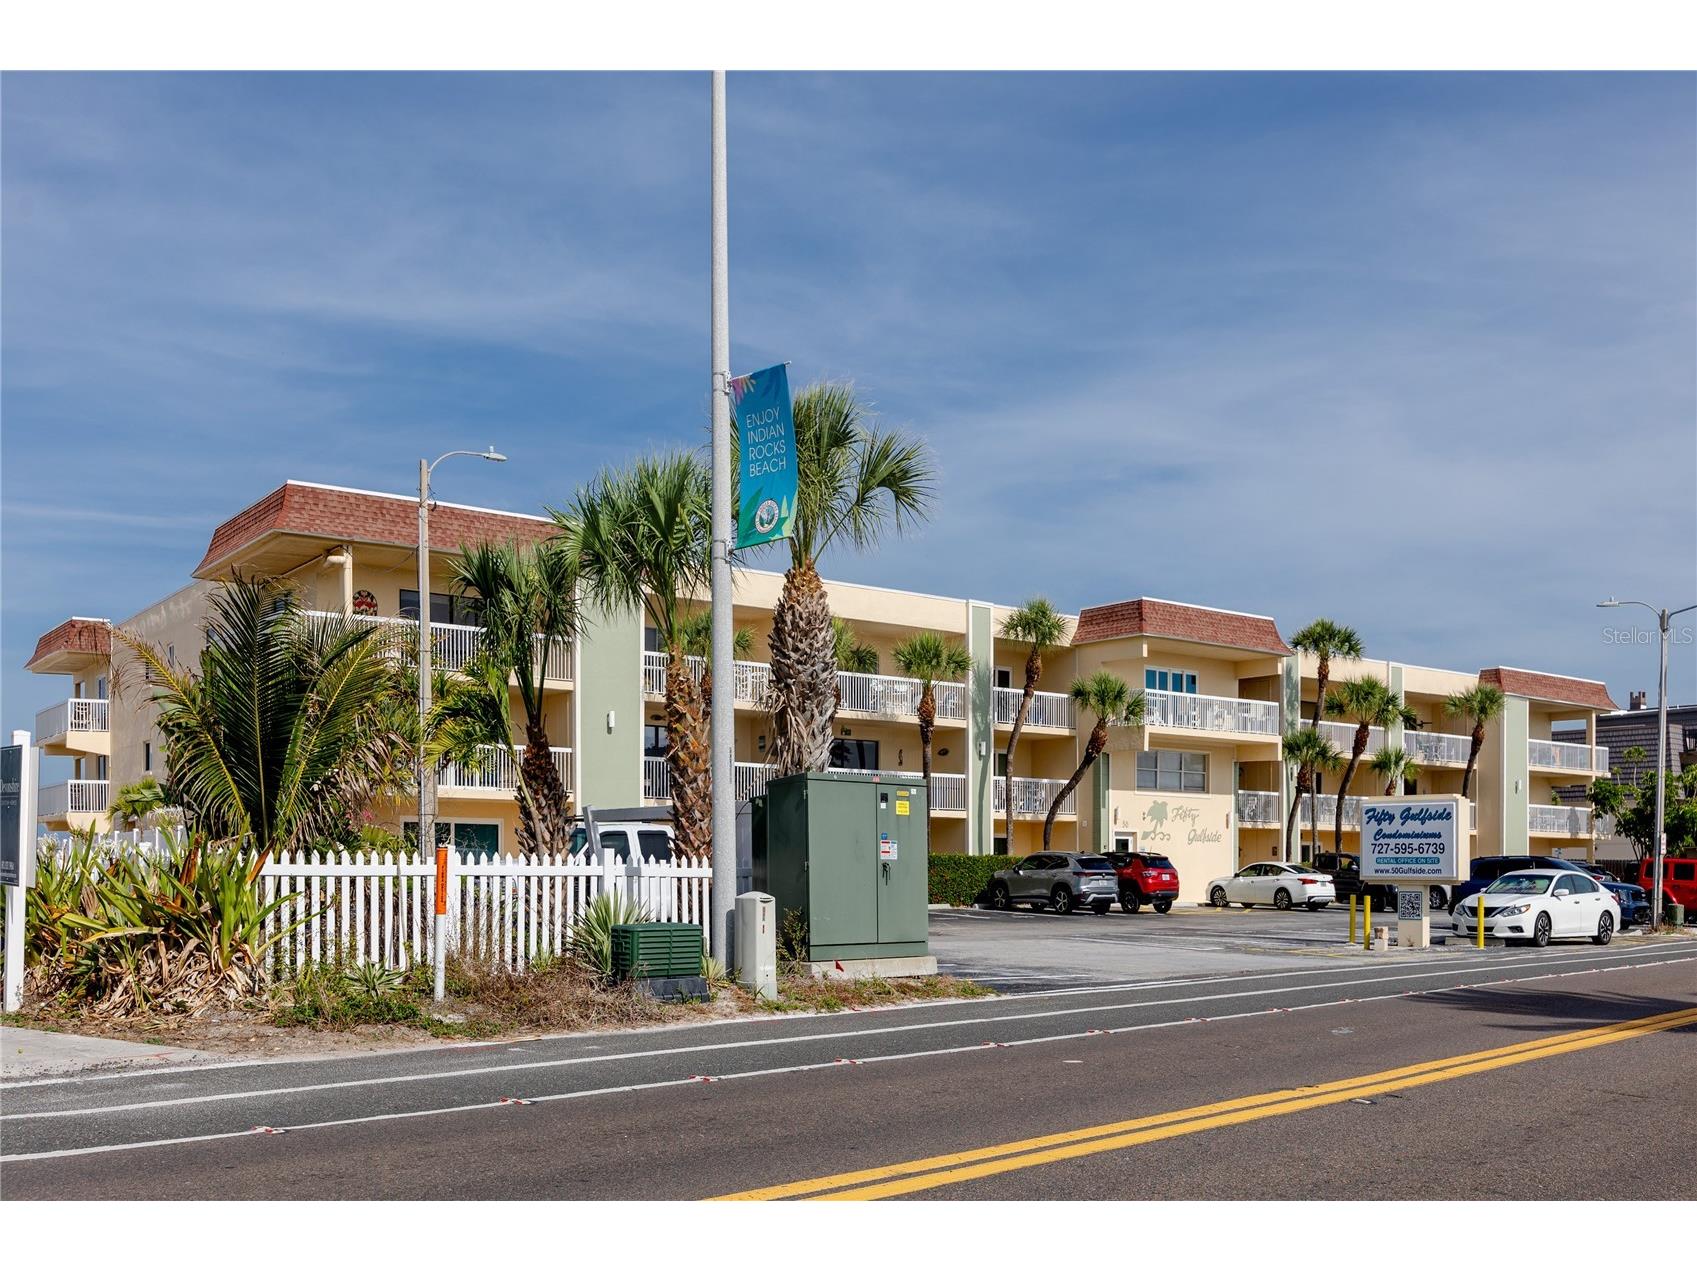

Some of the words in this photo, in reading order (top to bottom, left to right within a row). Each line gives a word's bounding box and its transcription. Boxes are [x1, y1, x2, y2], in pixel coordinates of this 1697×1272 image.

[746, 407, 780, 428] ENJOY
[747, 422, 784, 444] INDIAN
[749, 440, 786, 460] ROCKS
[749, 457, 786, 477] BEACH
[1171, 805, 1200, 827] Fifty
[1365, 807, 1395, 826] Fifty
[1400, 807, 1452, 826] Gulfside
[1187, 828, 1222, 846] Gulfside
[1374, 828, 1442, 841] Condominiums
[1371, 842, 1445, 855] 727-595-6739
[1374, 867, 1442, 875] www.50Gulfside.com
